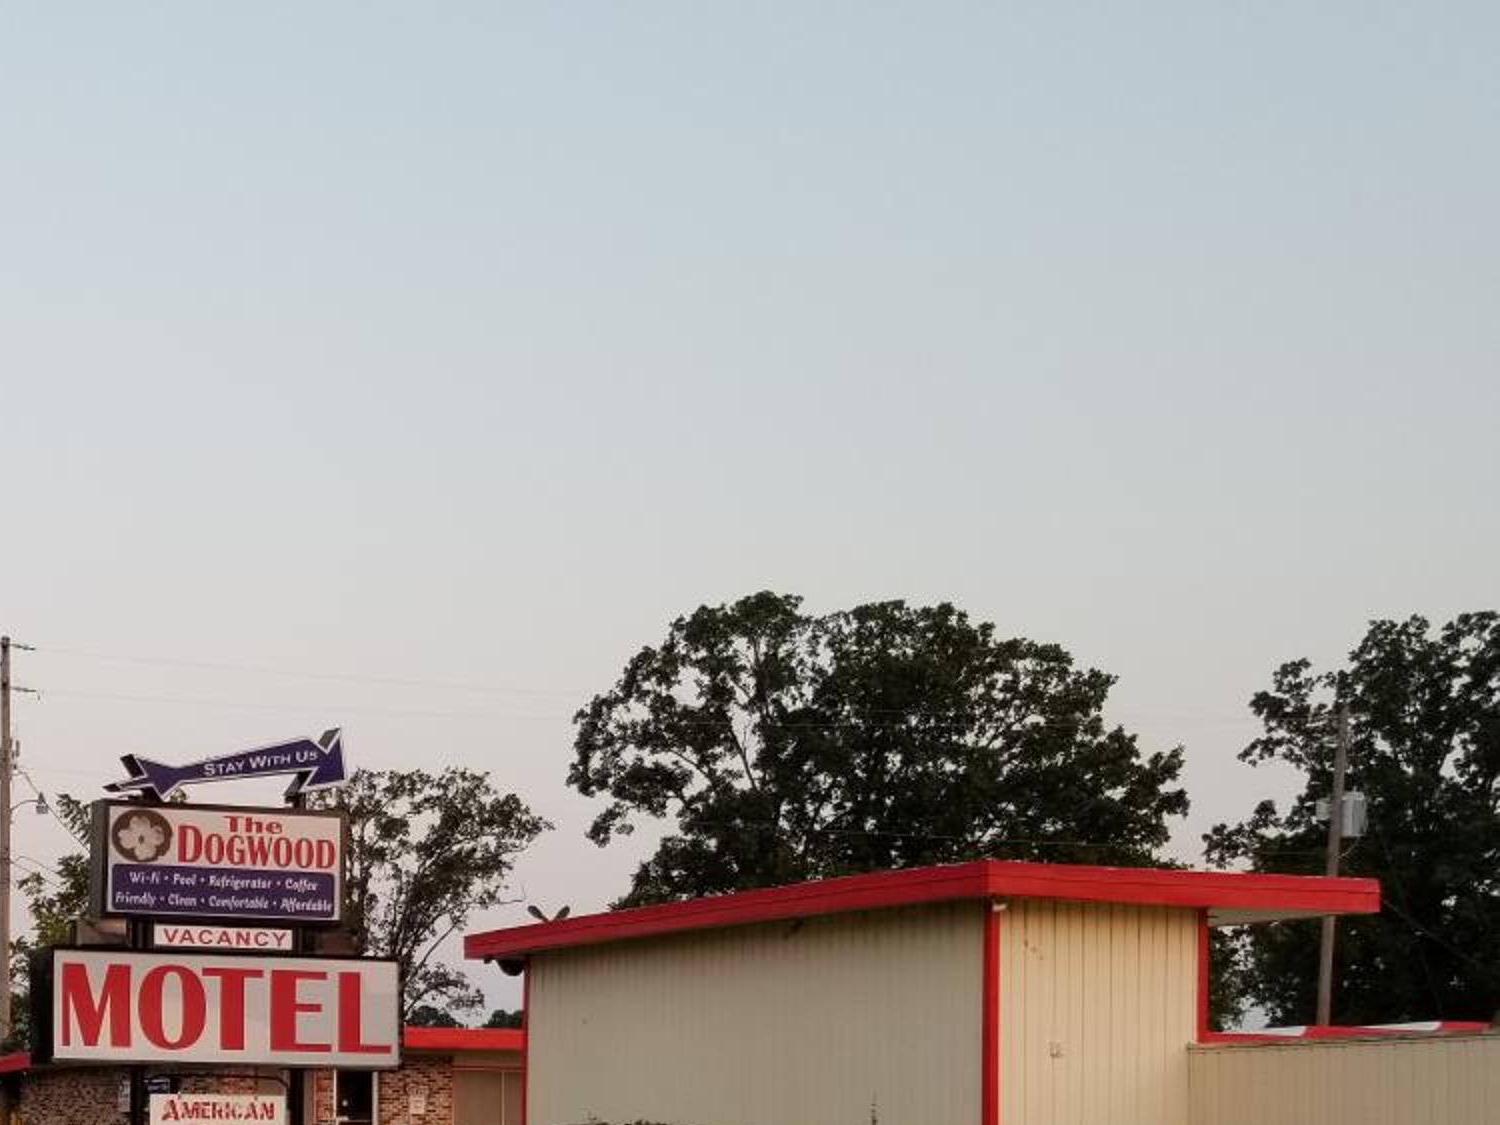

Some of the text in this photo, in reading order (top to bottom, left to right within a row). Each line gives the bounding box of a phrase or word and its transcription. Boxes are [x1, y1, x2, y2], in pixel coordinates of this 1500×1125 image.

[223, 815, 283, 834] The
[178, 825, 336, 869] DOGWOOD
[173, 874, 197, 886] Pool
[208, 875, 272, 891] Refrigerator
[285, 877, 318, 893] Coffee
[115, 891, 333, 913] Friendly Clean Comfortable Affordable
[164, 927, 287, 948] VACANCY
[62, 963, 393, 1055] MOTEL
[162, 1100, 275, 1120] AMERICAN
